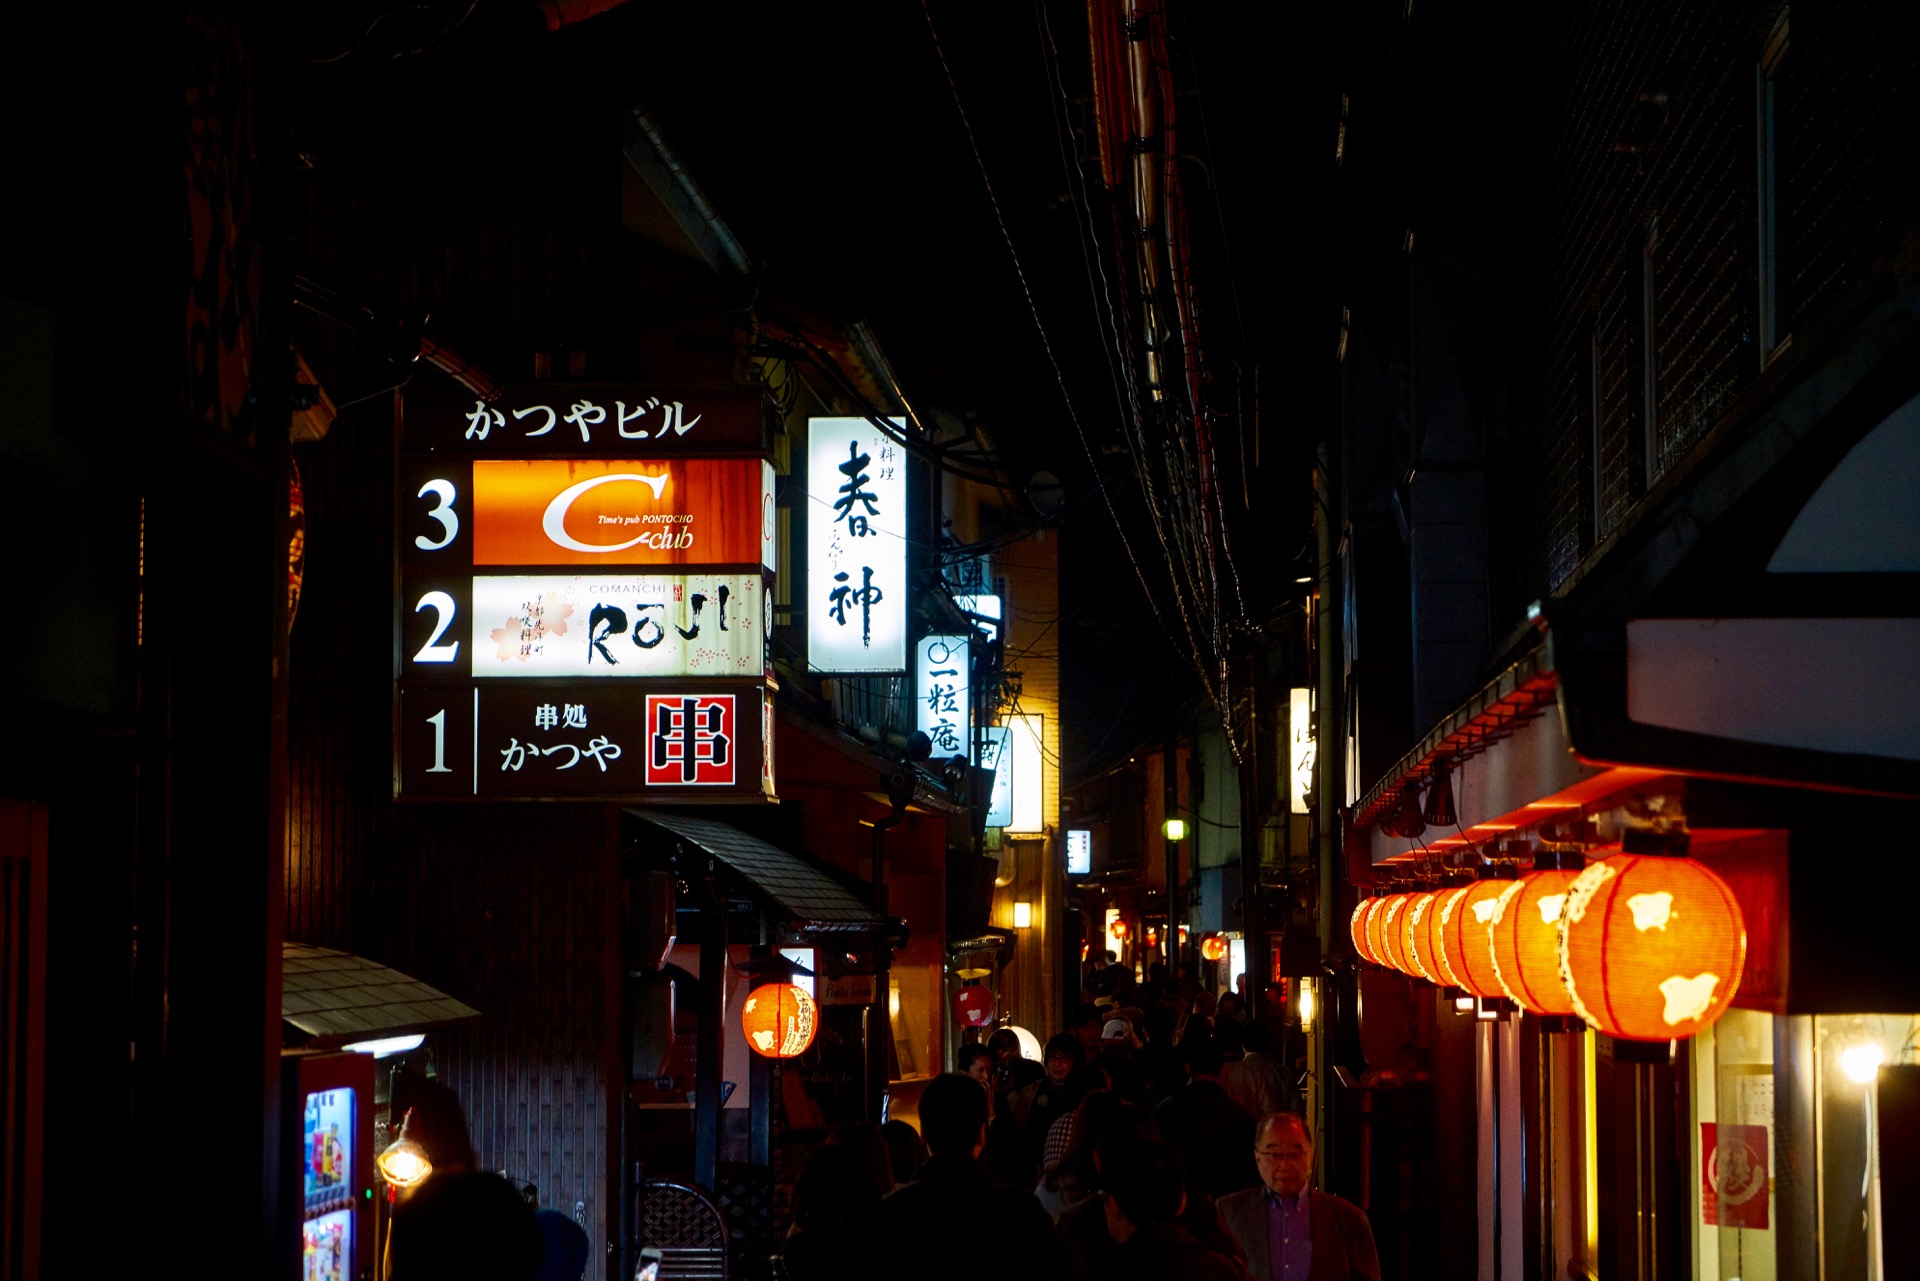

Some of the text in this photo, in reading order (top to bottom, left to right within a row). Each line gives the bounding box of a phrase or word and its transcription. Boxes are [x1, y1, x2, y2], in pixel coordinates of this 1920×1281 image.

[464, 396, 702, 442] かつやビル
[414, 478, 460, 551] 3
[598, 514, 694, 526] Time's pub PONTOCHO
[589, 584, 666, 594] COMANCHI
[412, 591, 460, 663] 2
[534, 703, 588, 731] 串処
[927, 668, 960, 752] 一粒庵
[425, 709, 453, 773] 1
[500, 734, 622, 773] かつや
[651, 697, 730, 783] 串
